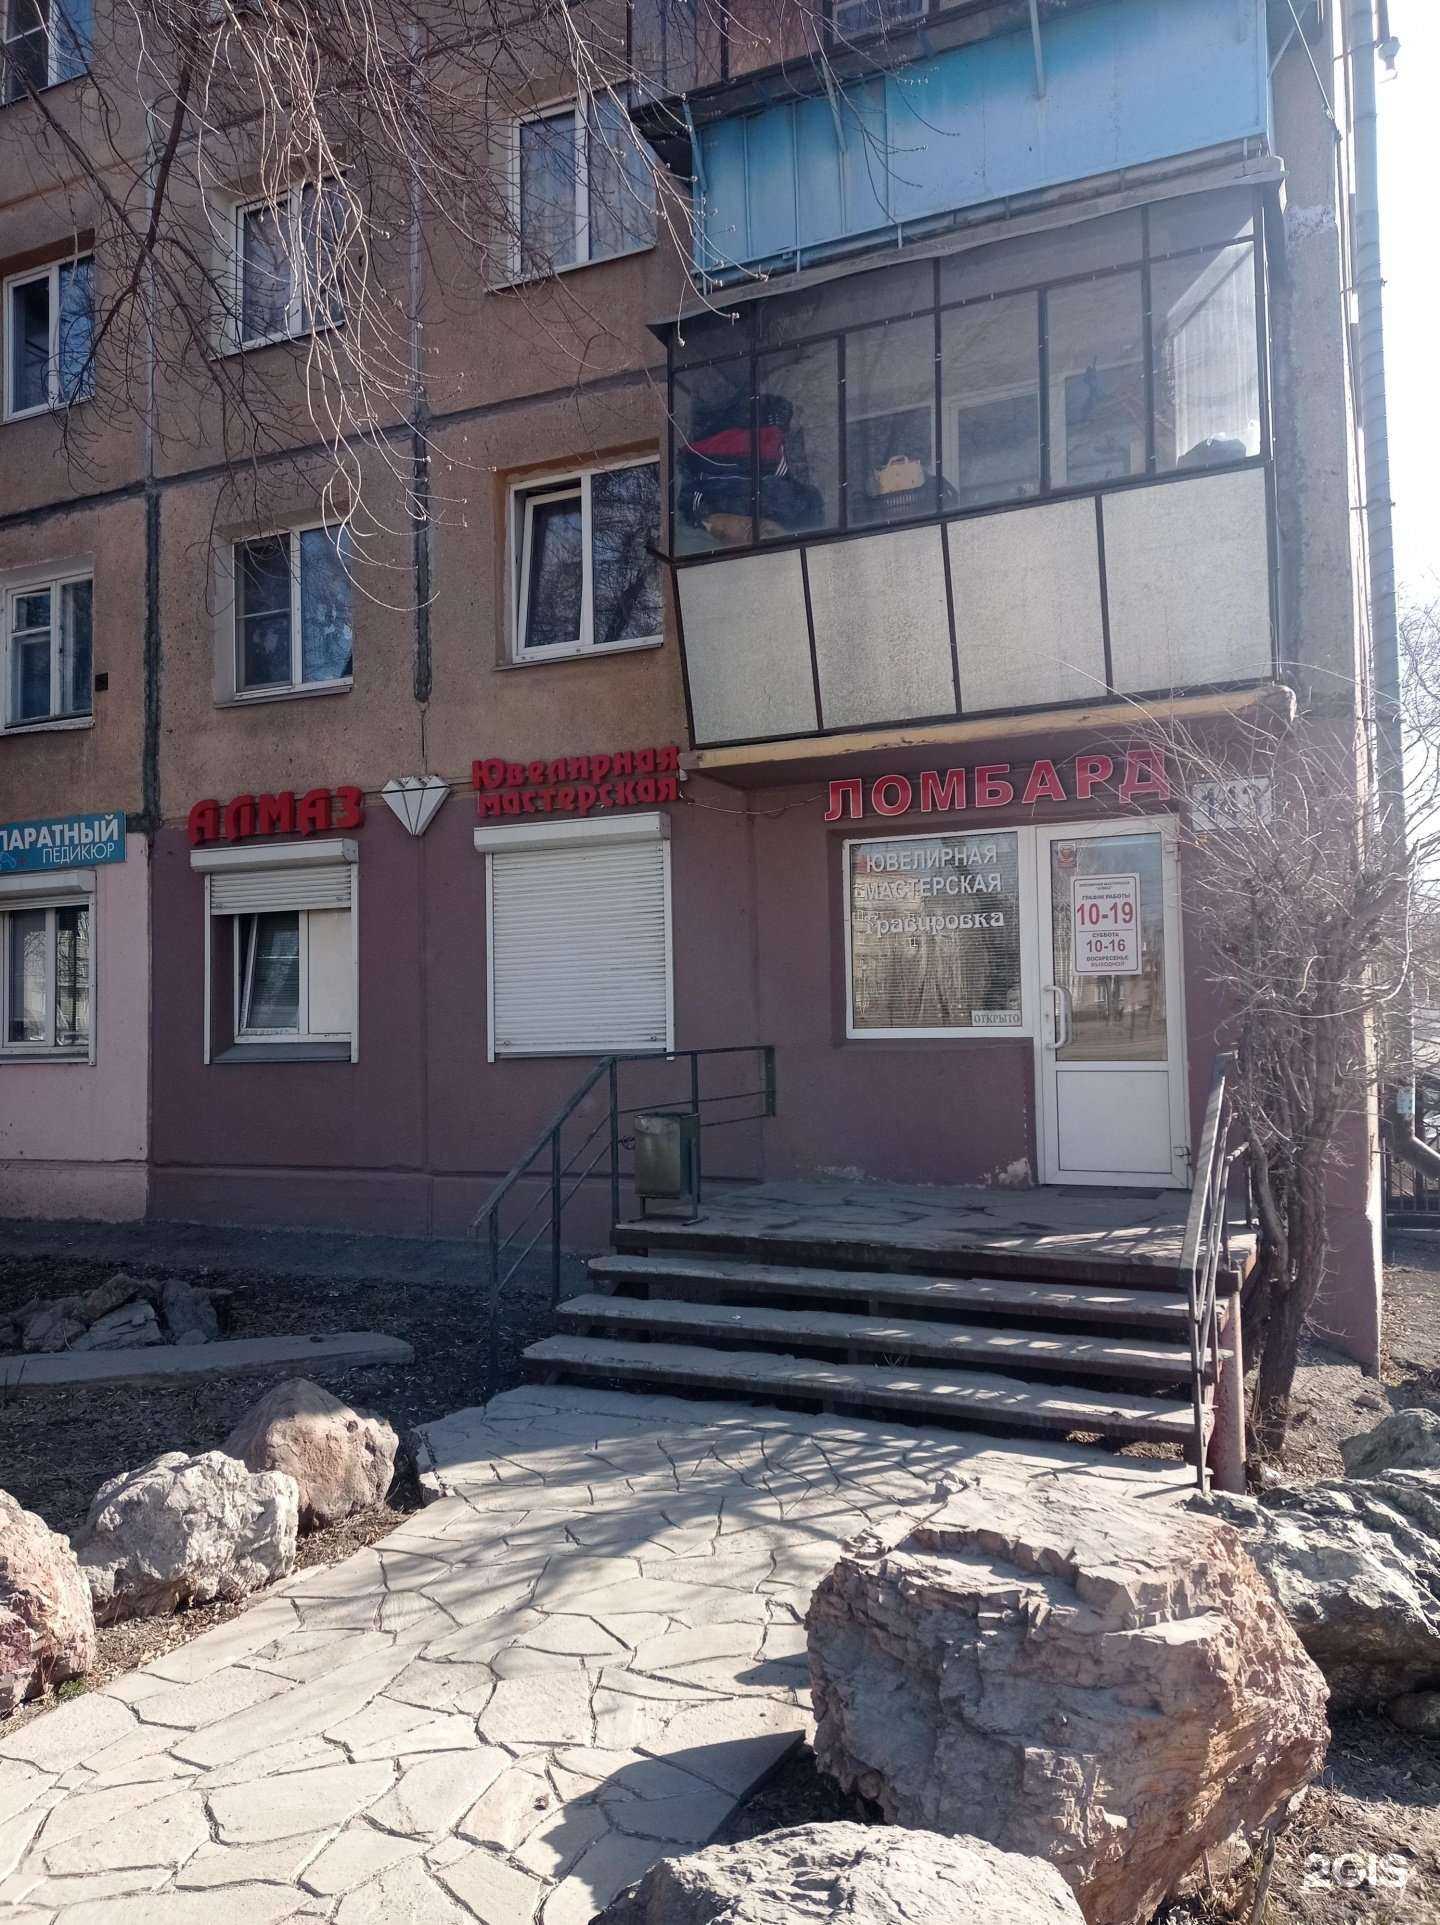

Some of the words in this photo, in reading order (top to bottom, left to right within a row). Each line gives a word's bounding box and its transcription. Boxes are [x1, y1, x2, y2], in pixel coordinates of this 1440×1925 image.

[471, 746, 680, 790] Ювелирная
[477, 776, 680, 818] мастерская
[824, 750, 1171, 821] ЛОМБАРД
[187, 785, 364, 846] АЛМАЗ
[43, 842, 115, 865] ПЕДИКЮР
[866, 845, 997, 873] ЮВЕЛИРНАЯ
[863, 873, 1001, 901] МАСТЕРСКАЯ
[864, 911, 1005, 938] Гравировка
[1076, 901, 1134, 926] 10-19
[1086, 938, 1126, 953] 10-16
[973, 1012, 1020, 1025] ОТКРЫТО
